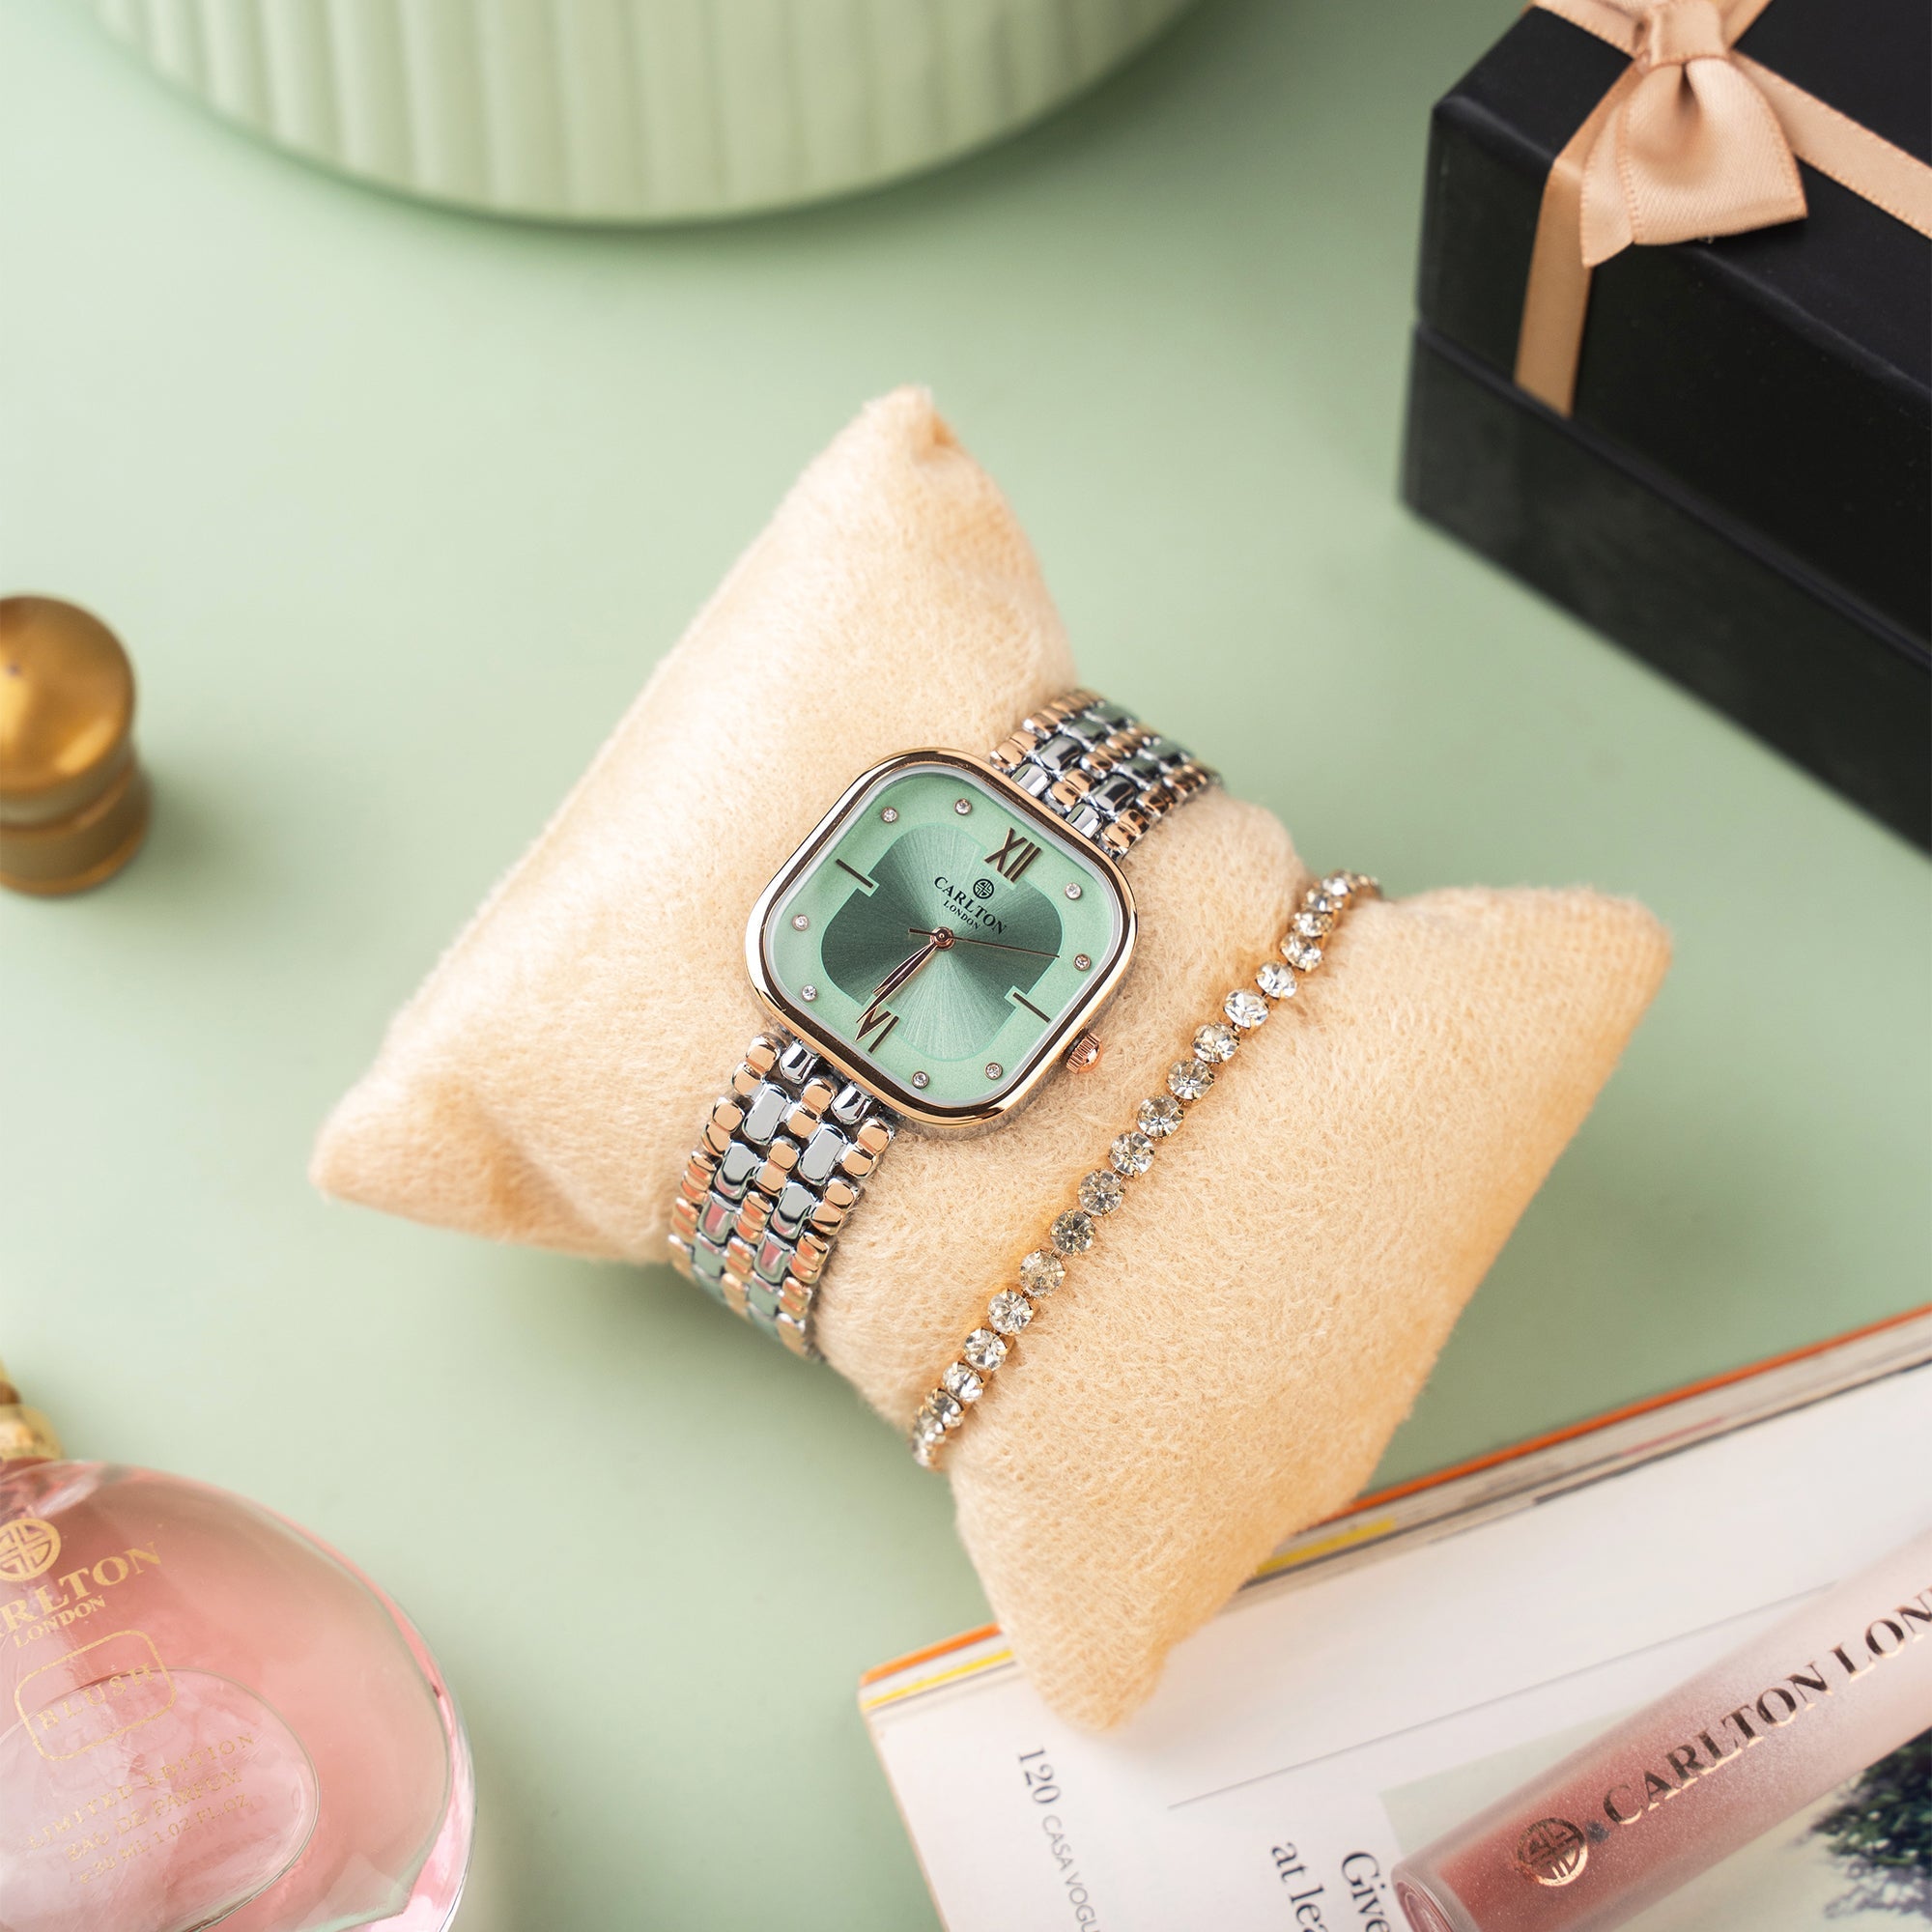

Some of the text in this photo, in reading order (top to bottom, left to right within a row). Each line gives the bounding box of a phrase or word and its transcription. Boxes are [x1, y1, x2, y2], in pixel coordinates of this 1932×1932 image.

[984, 827, 1041, 883] XII
[934, 876, 1007, 935] CARLTON
[943, 900, 980, 930] LONDON
[0, 1541, 162, 1637] RLTON
[13, 1594, 106, 1648] LONDON
[36, 1662, 156, 1731] BLUSH
[1603, 1585, 1932, 1825] CARLTON LON
[28, 1783, 133, 1850] LIMITED
[65, 1768, 242, 1862] EAU DE PARFUM
[1018, 1746, 1062, 1804] 120
[1042, 1814, 1075, 1872] CASA
[1270, 1841, 1308, 1884] at
[1341, 1850, 1391, 1932] Give
